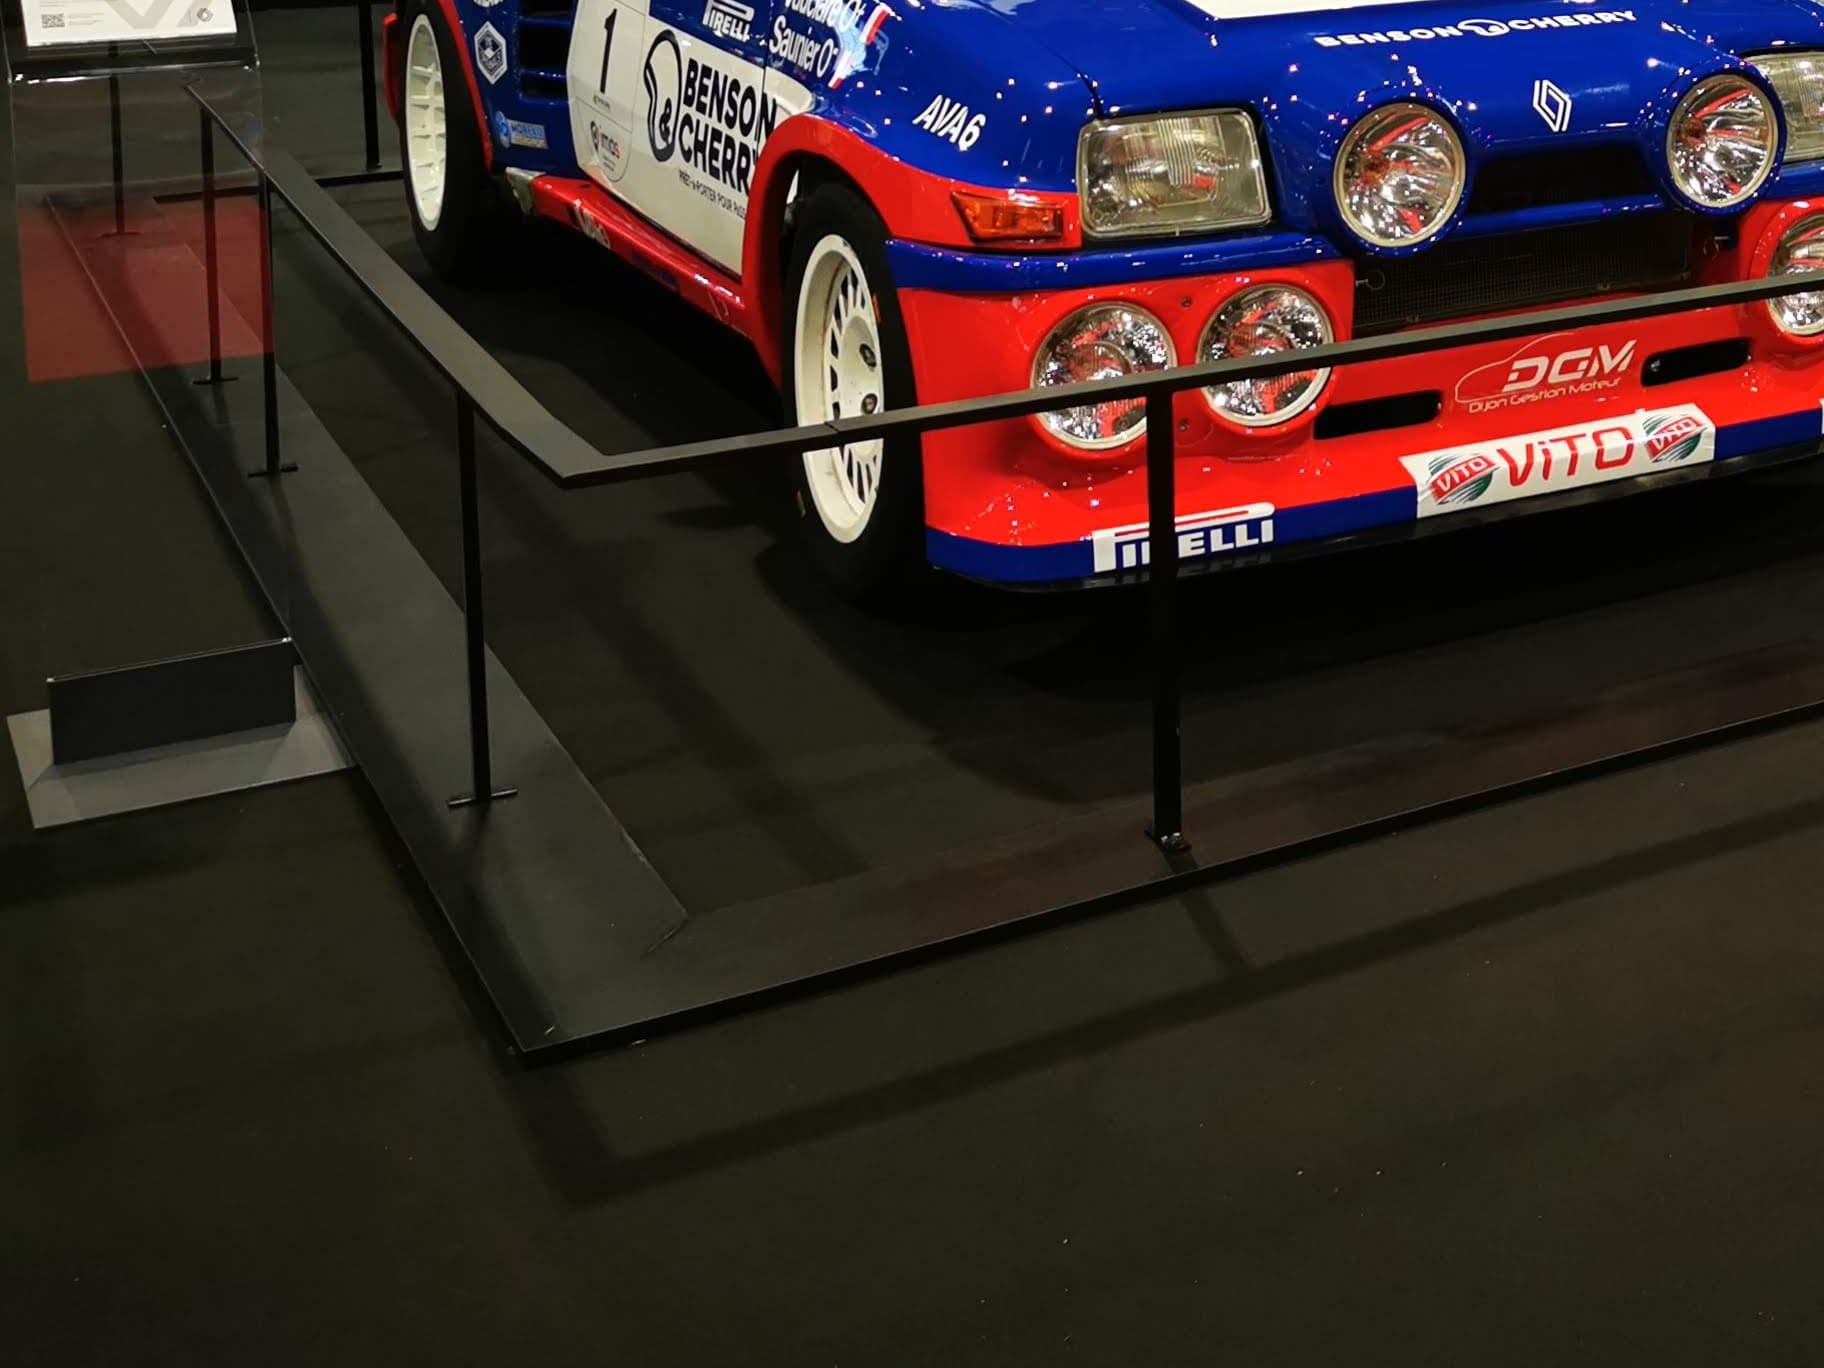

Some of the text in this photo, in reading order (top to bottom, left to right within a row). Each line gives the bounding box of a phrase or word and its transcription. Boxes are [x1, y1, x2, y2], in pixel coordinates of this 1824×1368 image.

[599, 8, 618, 95] 1
[768, 15, 820, 73] Saunier
[1313, 25, 1463, 47] BENSON
[1507, 9, 1637, 31] CHERRY
[683, 57, 777, 144] BENSON
[911, 94, 987, 152] AVA6
[678, 112, 759, 198] CHERR
[1468, 376, 1622, 415] Dijon Gestion Moteur
[1502, 339, 1638, 393] DGM
[1435, 455, 1489, 492] VITO
[1650, 416, 1695, 451] VITO
[1091, 501, 1276, 574] PIELLI
